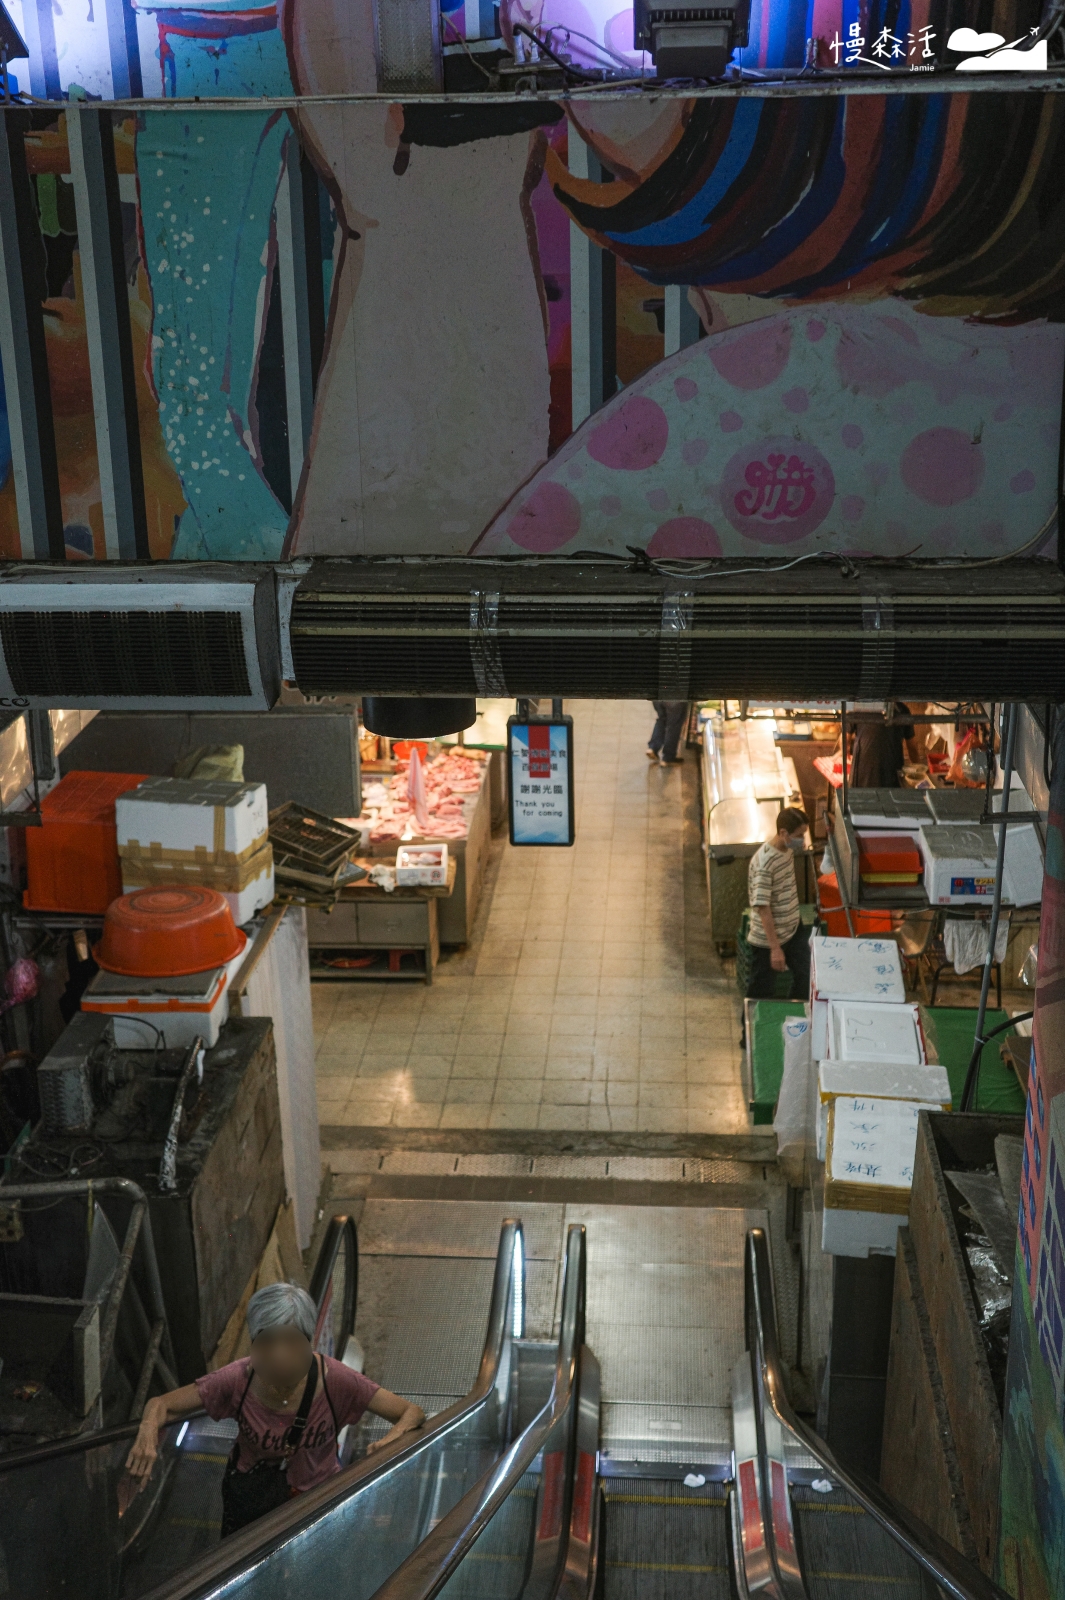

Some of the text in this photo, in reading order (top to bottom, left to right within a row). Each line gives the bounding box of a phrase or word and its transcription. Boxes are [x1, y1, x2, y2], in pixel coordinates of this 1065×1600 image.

[520, 784, 563, 794] 謝謝光臨
[514, 800, 537, 808] Thank
[522, 809, 534, 817] for
